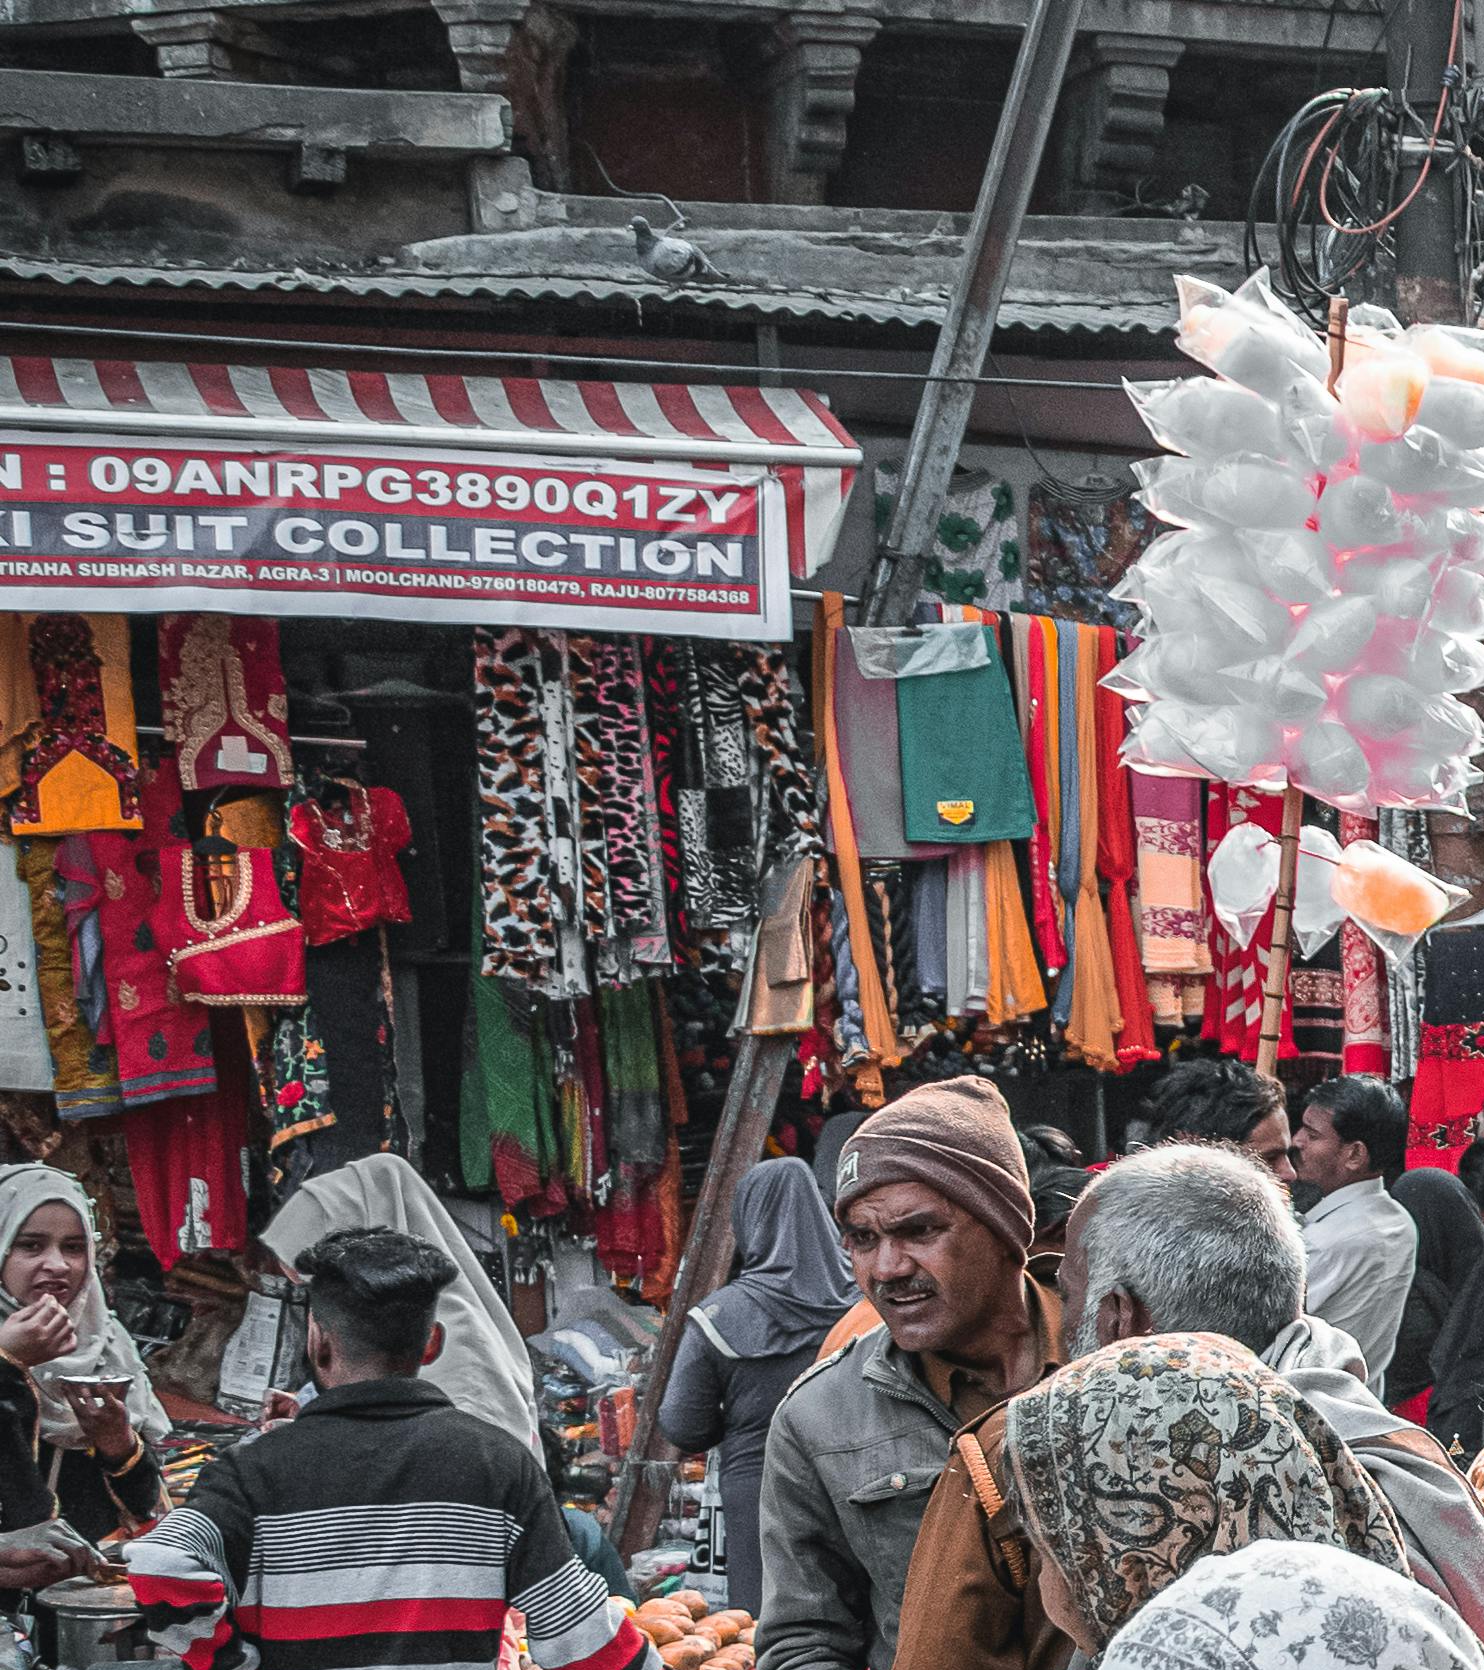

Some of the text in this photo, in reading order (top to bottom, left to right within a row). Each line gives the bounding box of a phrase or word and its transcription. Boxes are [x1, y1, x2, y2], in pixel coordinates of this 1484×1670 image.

[89, 456, 741, 525] 09ANRPG3890Q1ZY
[62, 511, 249, 552] SUIT
[274, 517, 744, 578] COLLECTION
[78, 562, 176, 578] SUBHASH
[182, 564, 254, 581] BAZAR,
[259, 566, 330, 582] AGRA-3
[346, 570, 586, 599] MOOLCHAND-9760180479,
[590, 582, 749, 605] RAJU-8077584368
